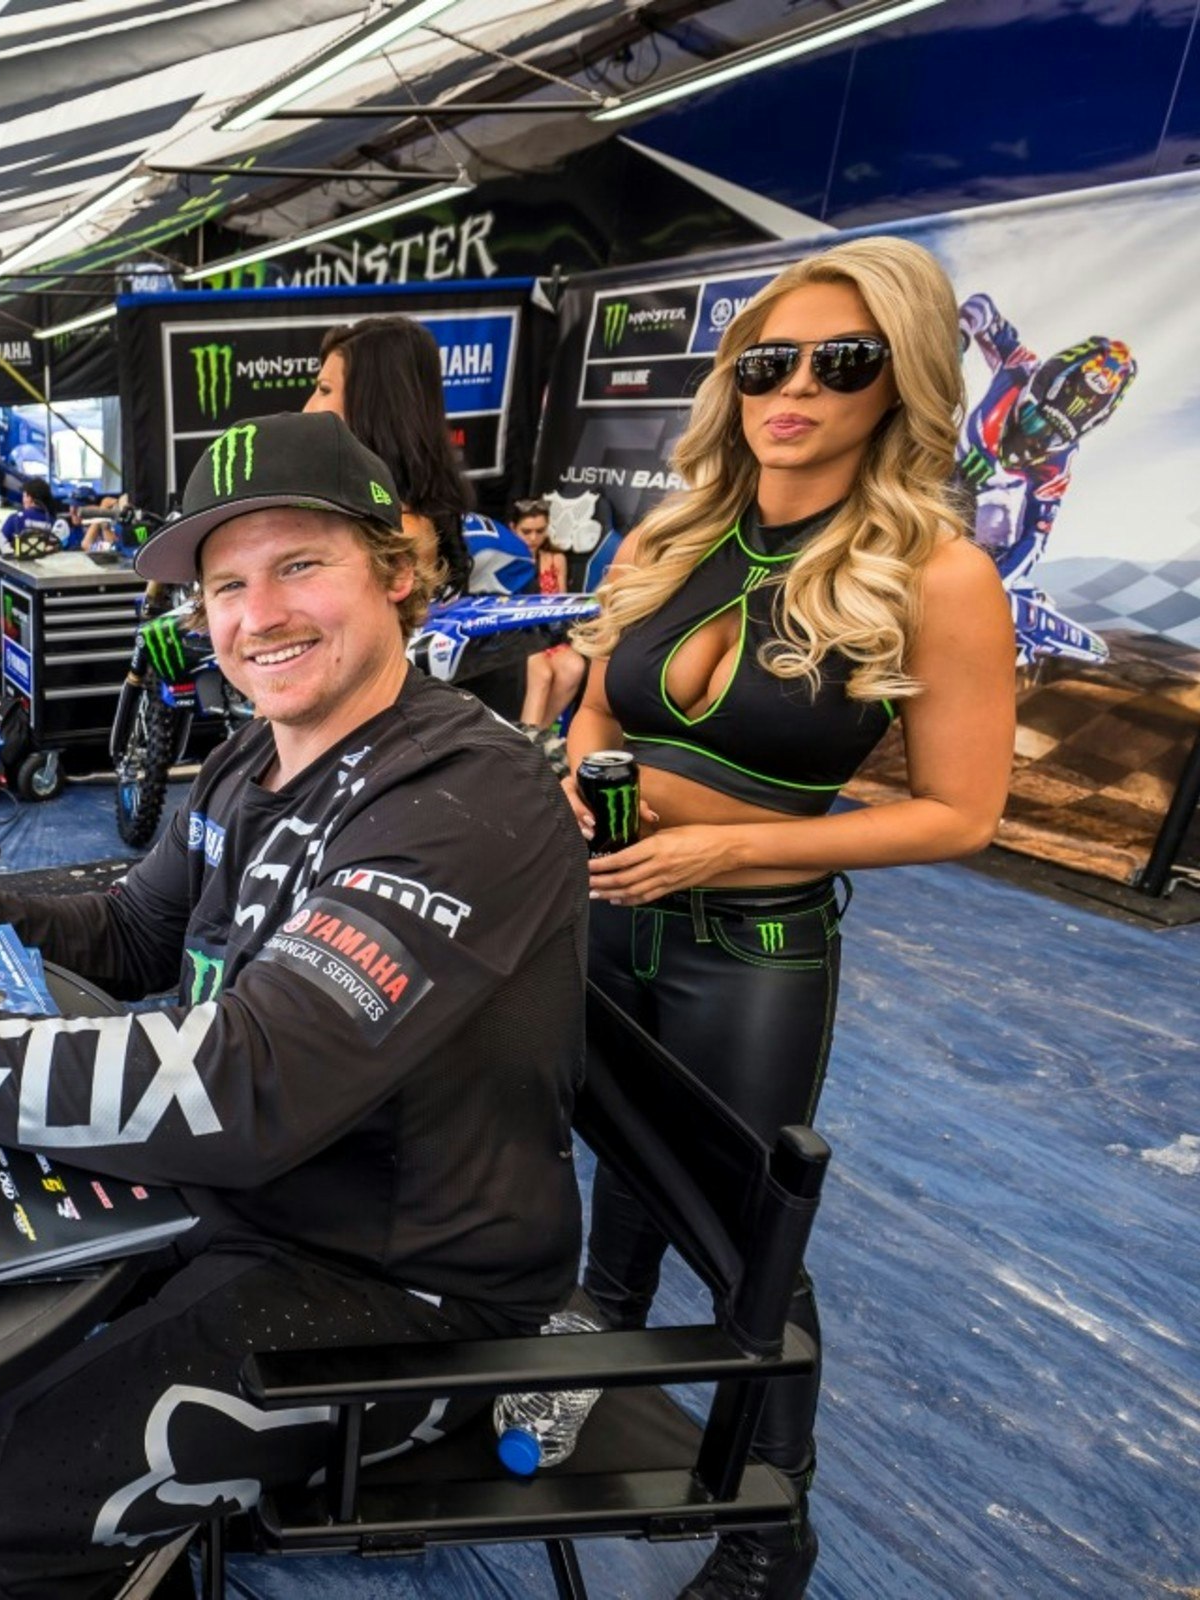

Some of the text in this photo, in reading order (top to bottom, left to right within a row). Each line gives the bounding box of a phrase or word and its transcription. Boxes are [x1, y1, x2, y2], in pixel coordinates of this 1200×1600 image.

[628, 307, 687, 325] MONSTER
[236, 355, 321, 379] MONSTE
[560, 466, 693, 491] JUSTIN BAR
[303, 910, 411, 1003] YAMAHA
[323, 961, 385, 1022] SERVICES
